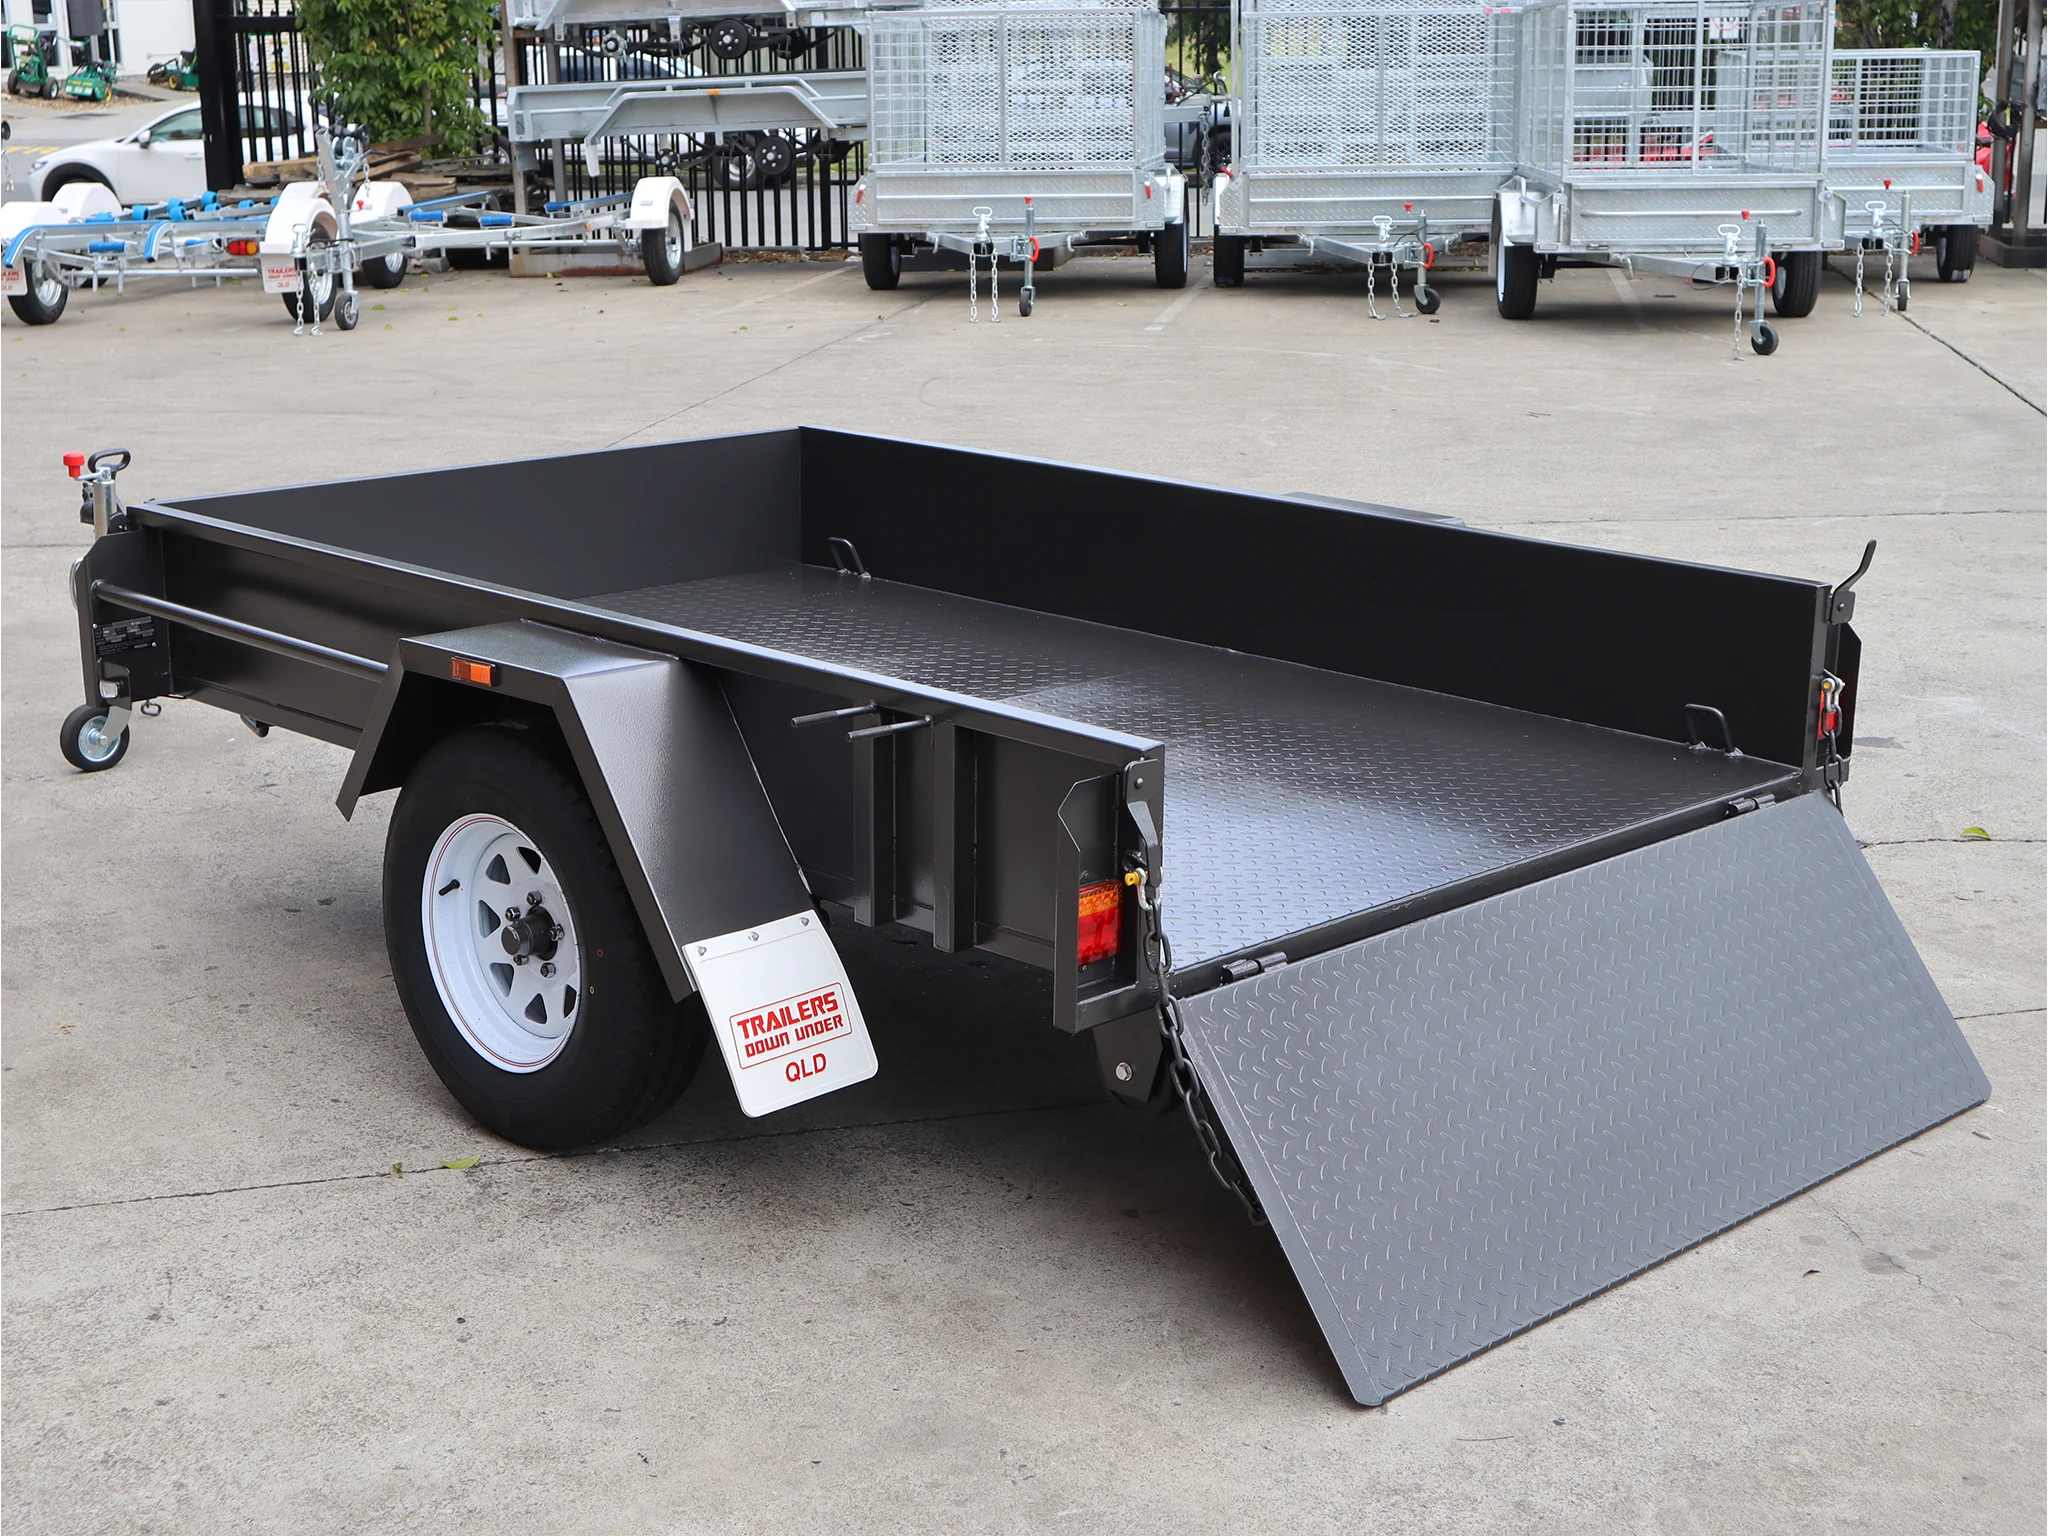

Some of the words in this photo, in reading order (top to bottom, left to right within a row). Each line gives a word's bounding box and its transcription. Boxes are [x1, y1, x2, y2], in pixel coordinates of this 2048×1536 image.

[737, 991, 839, 1039] TRAILERS
[744, 1031, 791, 1058] DOWN
[794, 1014, 844, 1042] UNDER
[785, 1052, 827, 1083] QLD
